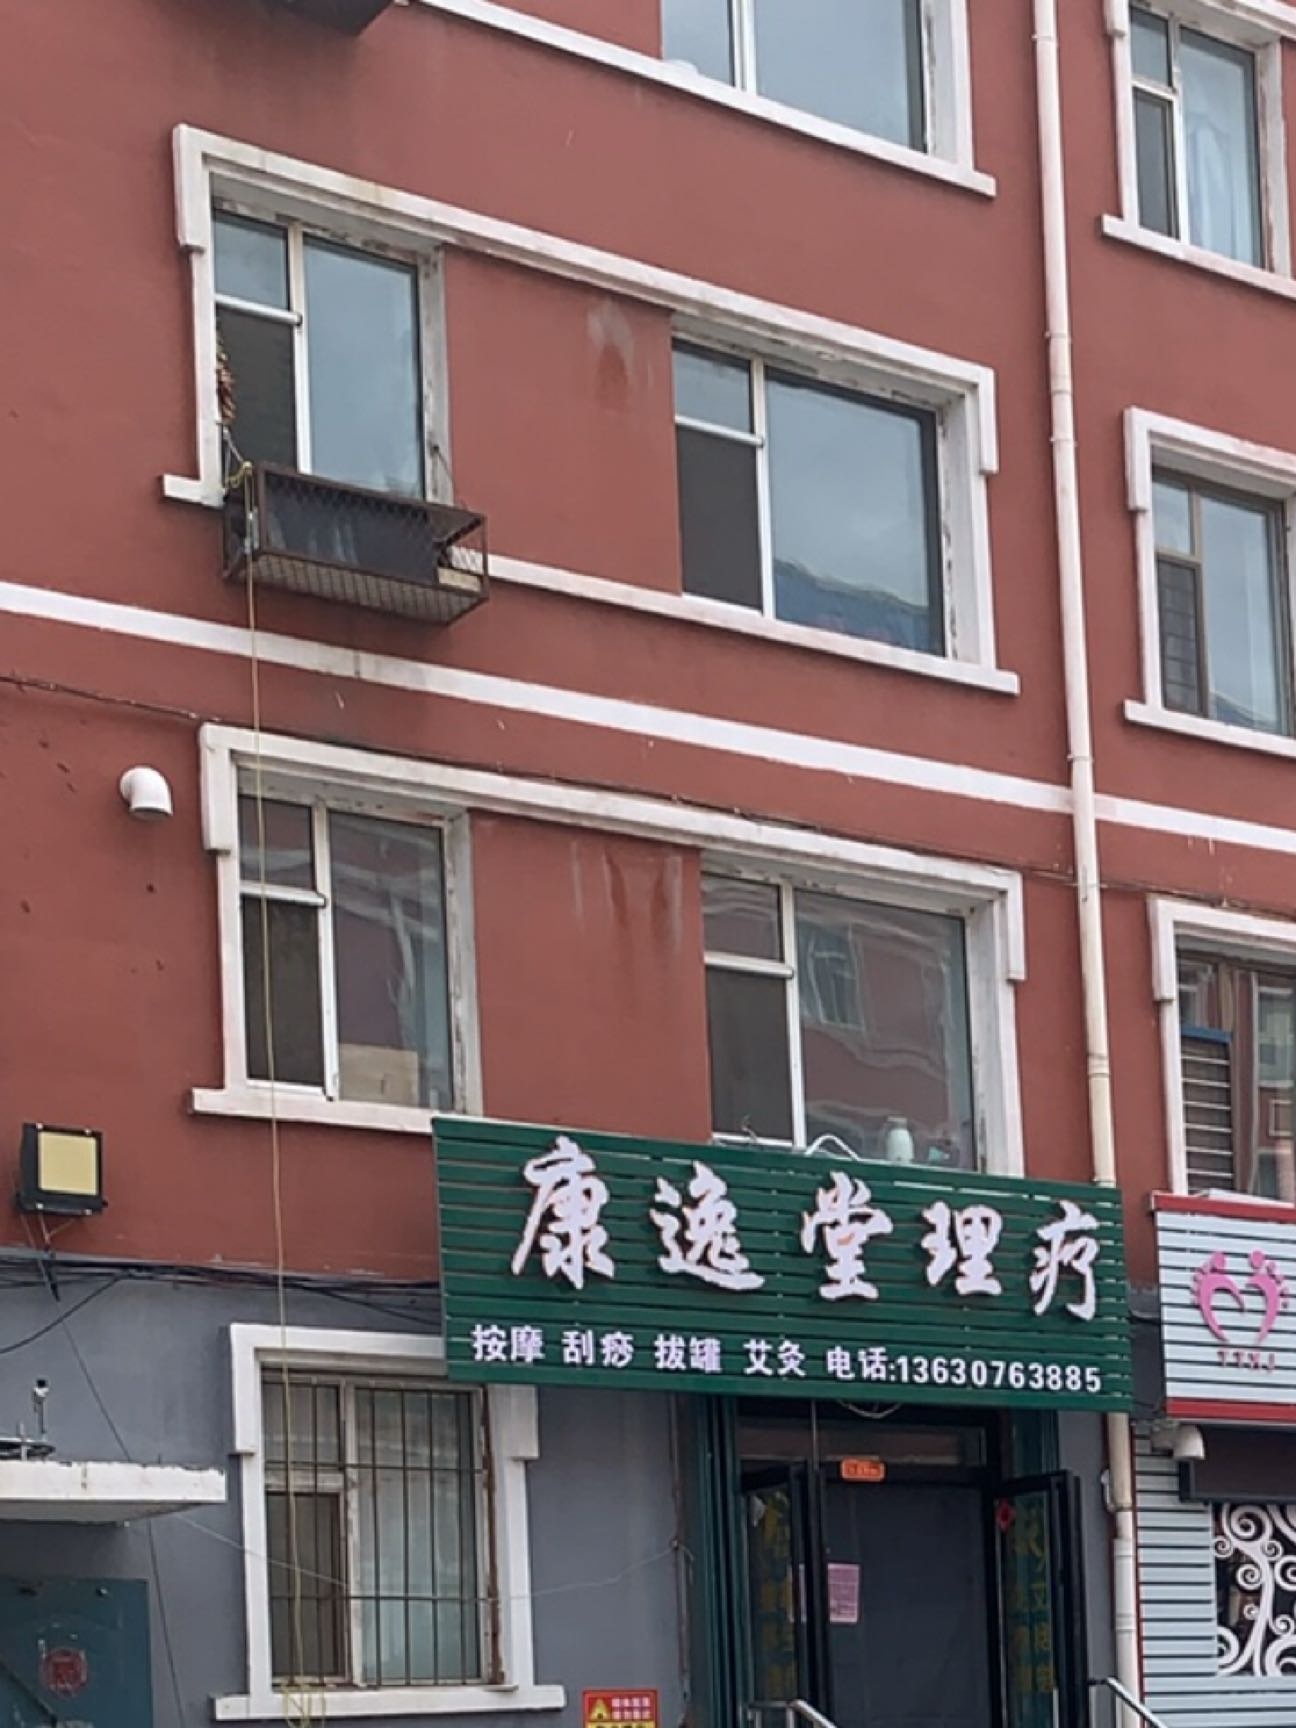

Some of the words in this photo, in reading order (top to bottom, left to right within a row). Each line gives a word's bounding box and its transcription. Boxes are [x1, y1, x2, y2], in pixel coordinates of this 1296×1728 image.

[511, 1136, 1100, 1321] 康逸堂理疗
[471, 1324, 545, 1363] 按摩
[561, 1329, 635, 1368] 刮痧
[653, 1333, 722, 1374] 拔罐
[742, 1338, 806, 1378] 艾灸
[825, 1345, 1102, 1393] 电话:13630763885
